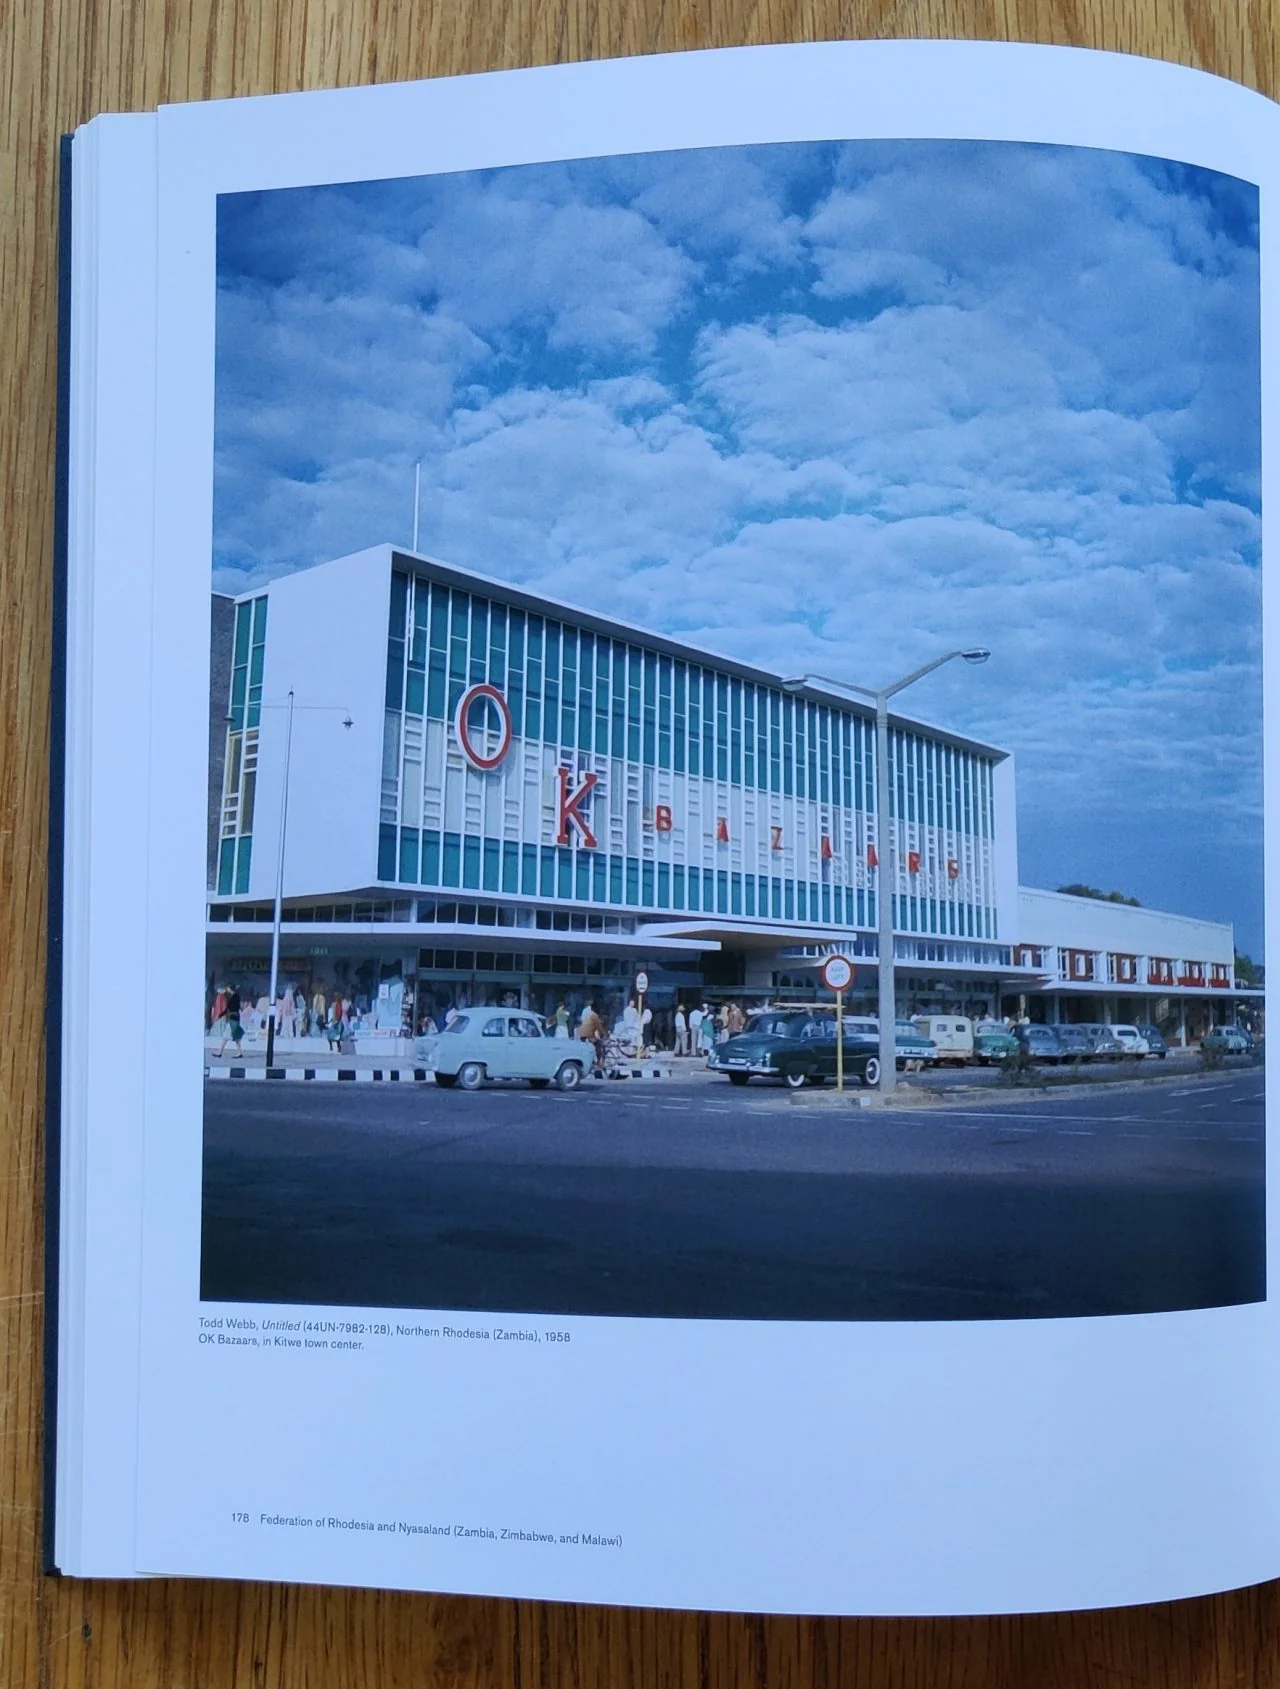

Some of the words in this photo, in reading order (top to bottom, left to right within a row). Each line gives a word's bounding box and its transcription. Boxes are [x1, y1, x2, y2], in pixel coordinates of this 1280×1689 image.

[654, 803, 960, 881] BAZAARS
[198, 1316, 224, 1331] Todd
[225, 1317, 259, 1332] Webb,
[261, 1318, 302, 1332] Untitled
[396, 1323, 440, 1338] Northern
[442, 1325, 490, 1340] Rhodesia
[493, 1327, 541, 1344] (Zambia),
[545, 1330, 571, 1344] 1958
[198, 1332, 215, 1345] OK
[217, 1332, 260, 1348] Bazaars,
[262, 1334, 272, 1347] in
[274, 1335, 302, 1349] Kitwe
[304, 1337, 328, 1350] town
[330, 1339, 364, 1351] center.
[231, 1511, 250, 1525] 178
[260, 1512, 313, 1528] Federation
[315, 1515, 326, 1529] of
[327, 1516, 375, 1532] Rhodesia
[377, 1520, 396, 1533] and
[398, 1521, 451, 1537] Nyasaland
[453, 1524, 498, 1541] (Zambia,
[500, 1527, 557, 1546] Zimbabwe,
[559, 1532, 579, 1545] and
[581, 1532, 623, 1549] Malawi)
